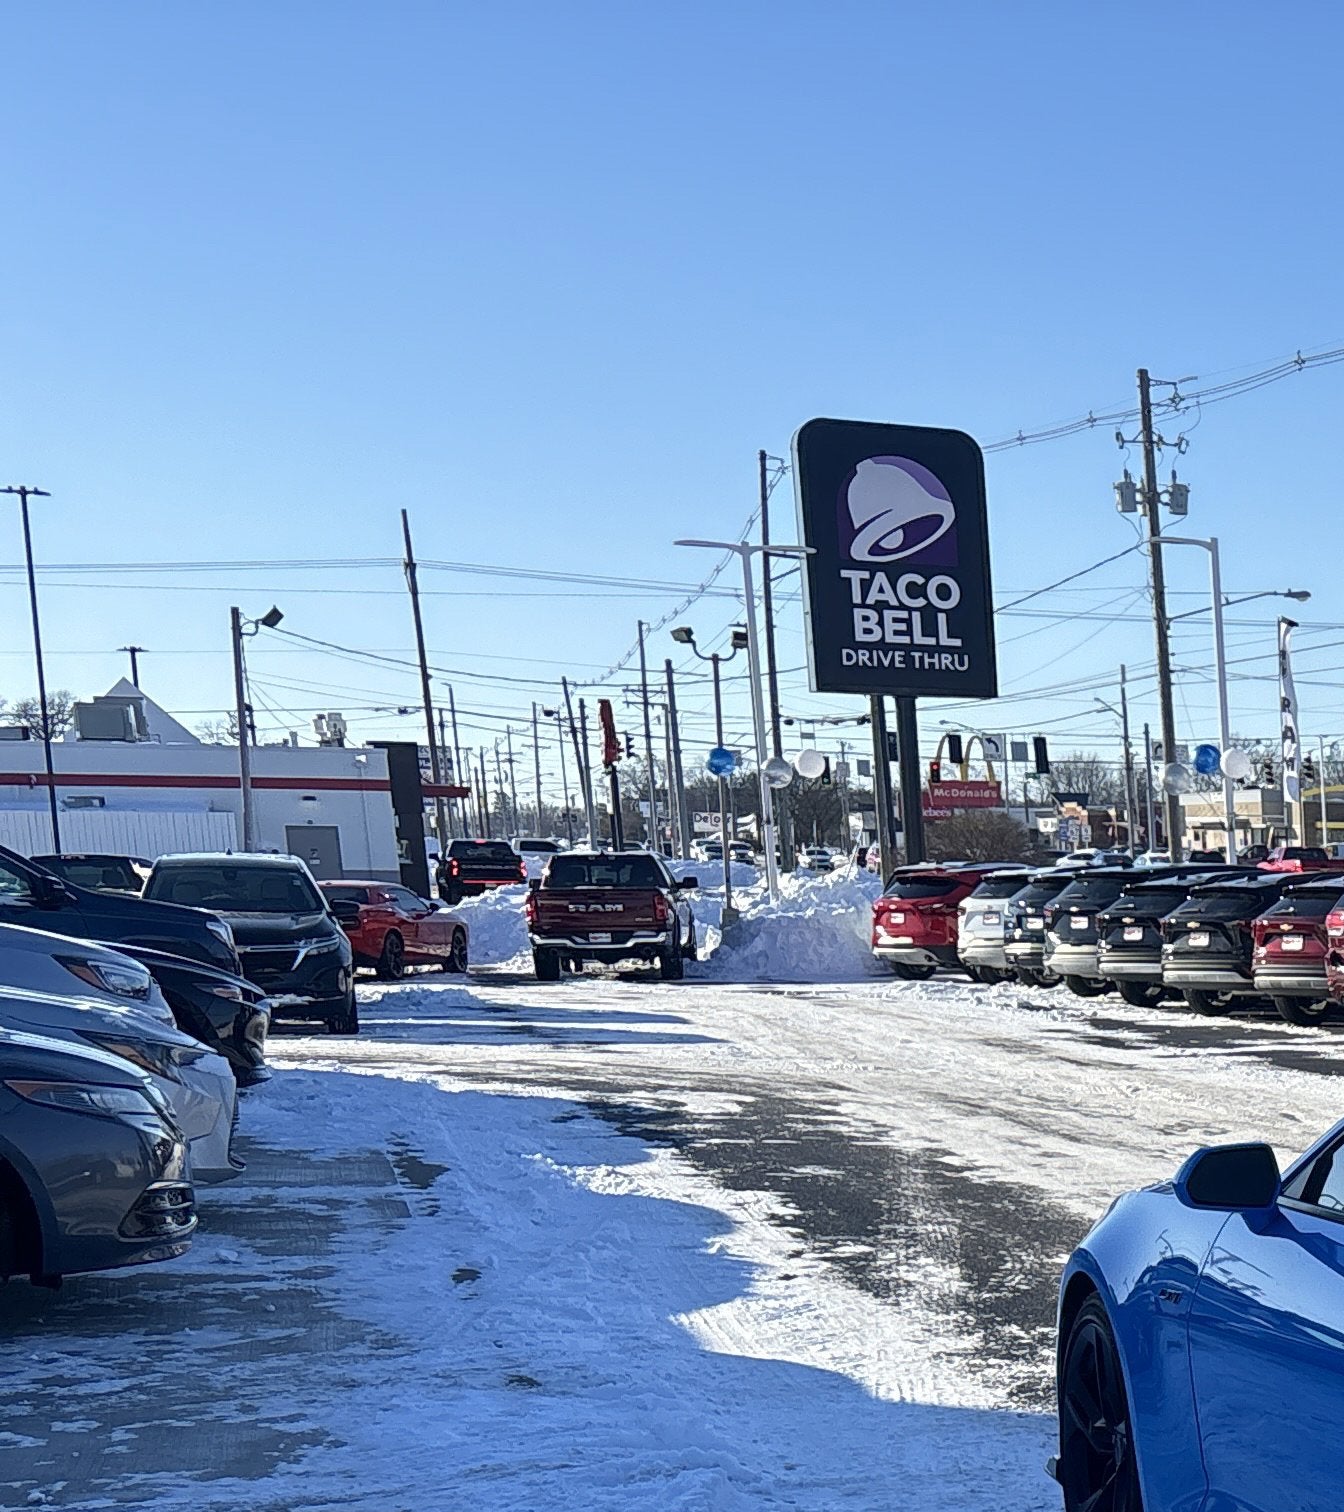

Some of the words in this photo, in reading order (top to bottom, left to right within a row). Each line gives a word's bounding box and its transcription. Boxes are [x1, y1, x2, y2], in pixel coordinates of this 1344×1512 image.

[840, 569, 961, 610] TACO
[853, 608, 963, 647] BELL
[842, 649, 906, 668] DRIVE
[911, 651, 969, 672] THRU
[933, 788, 998, 799] McDonald's
[568, 903, 624, 913] RAM
